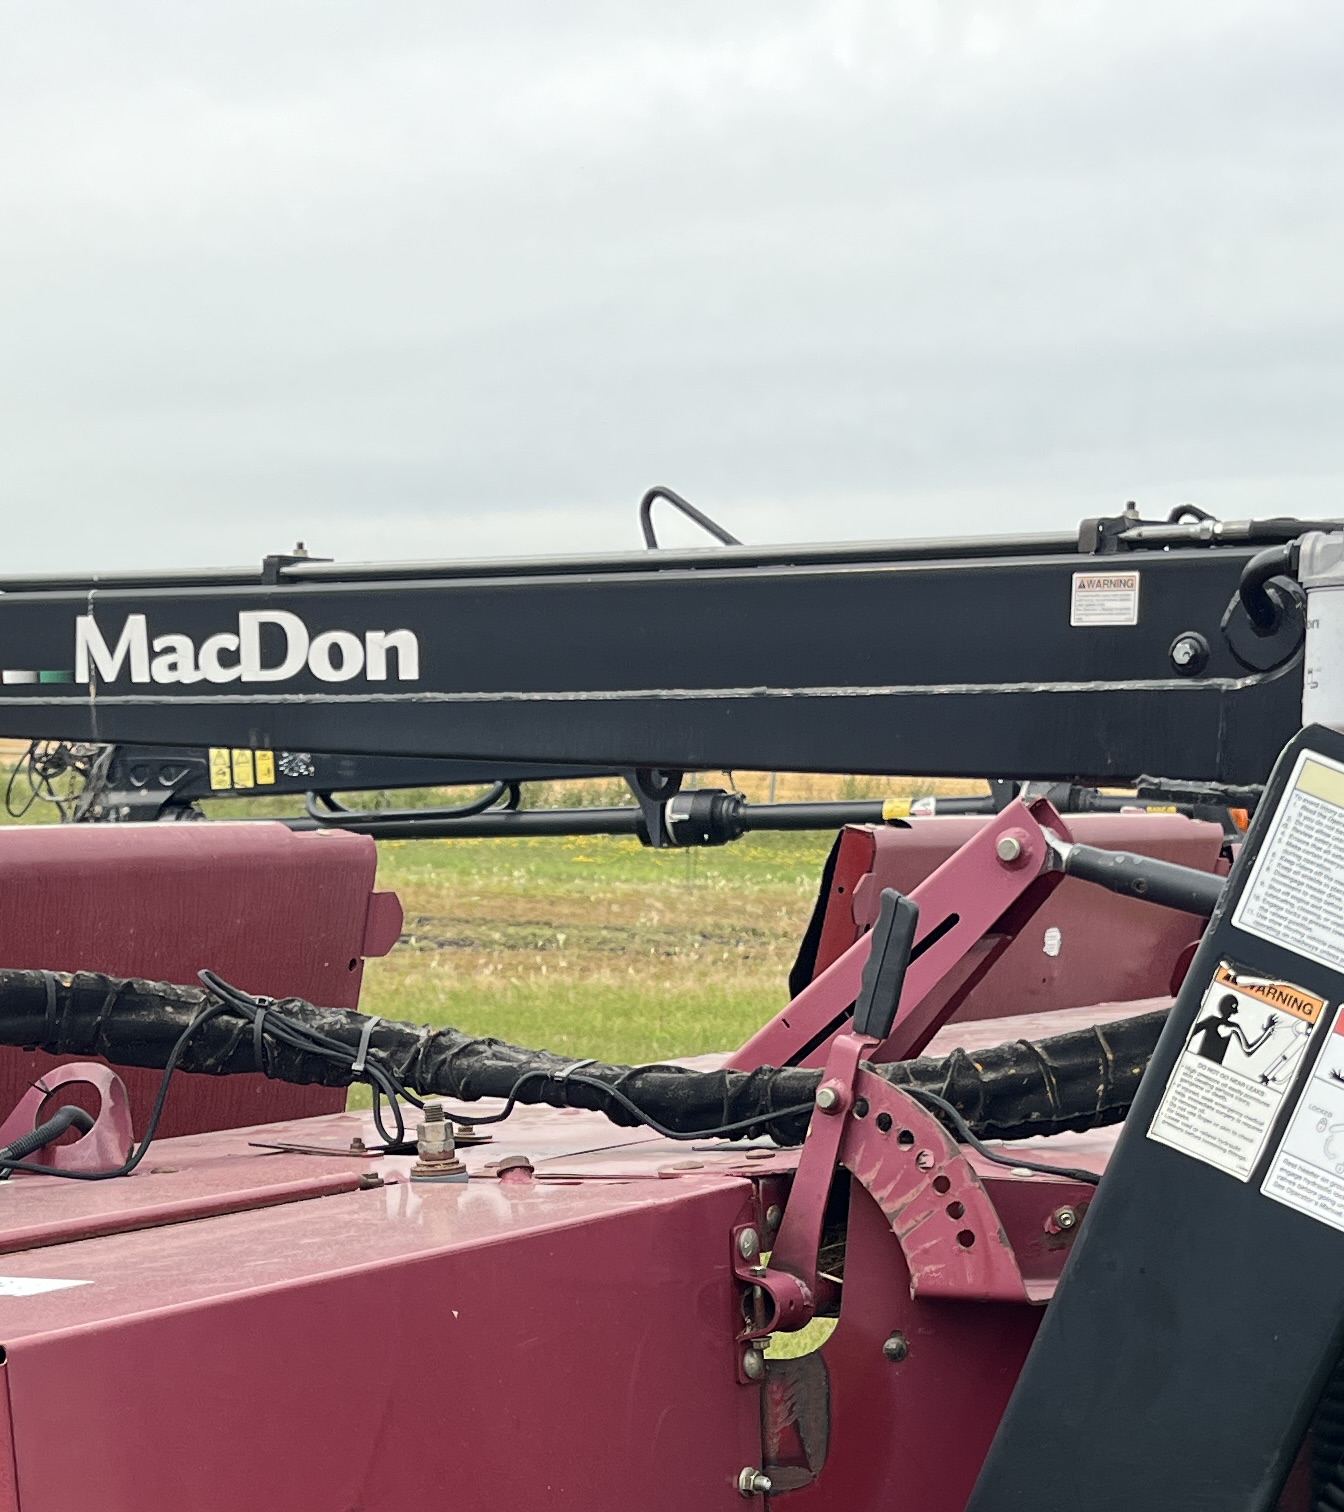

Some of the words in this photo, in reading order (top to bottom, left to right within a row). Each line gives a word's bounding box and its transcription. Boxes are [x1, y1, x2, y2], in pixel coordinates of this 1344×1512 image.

[1086, 578, 1134, 589] WARNING
[75, 610, 420, 684] MacDon
[1249, 984, 1314, 1016] ARNING
